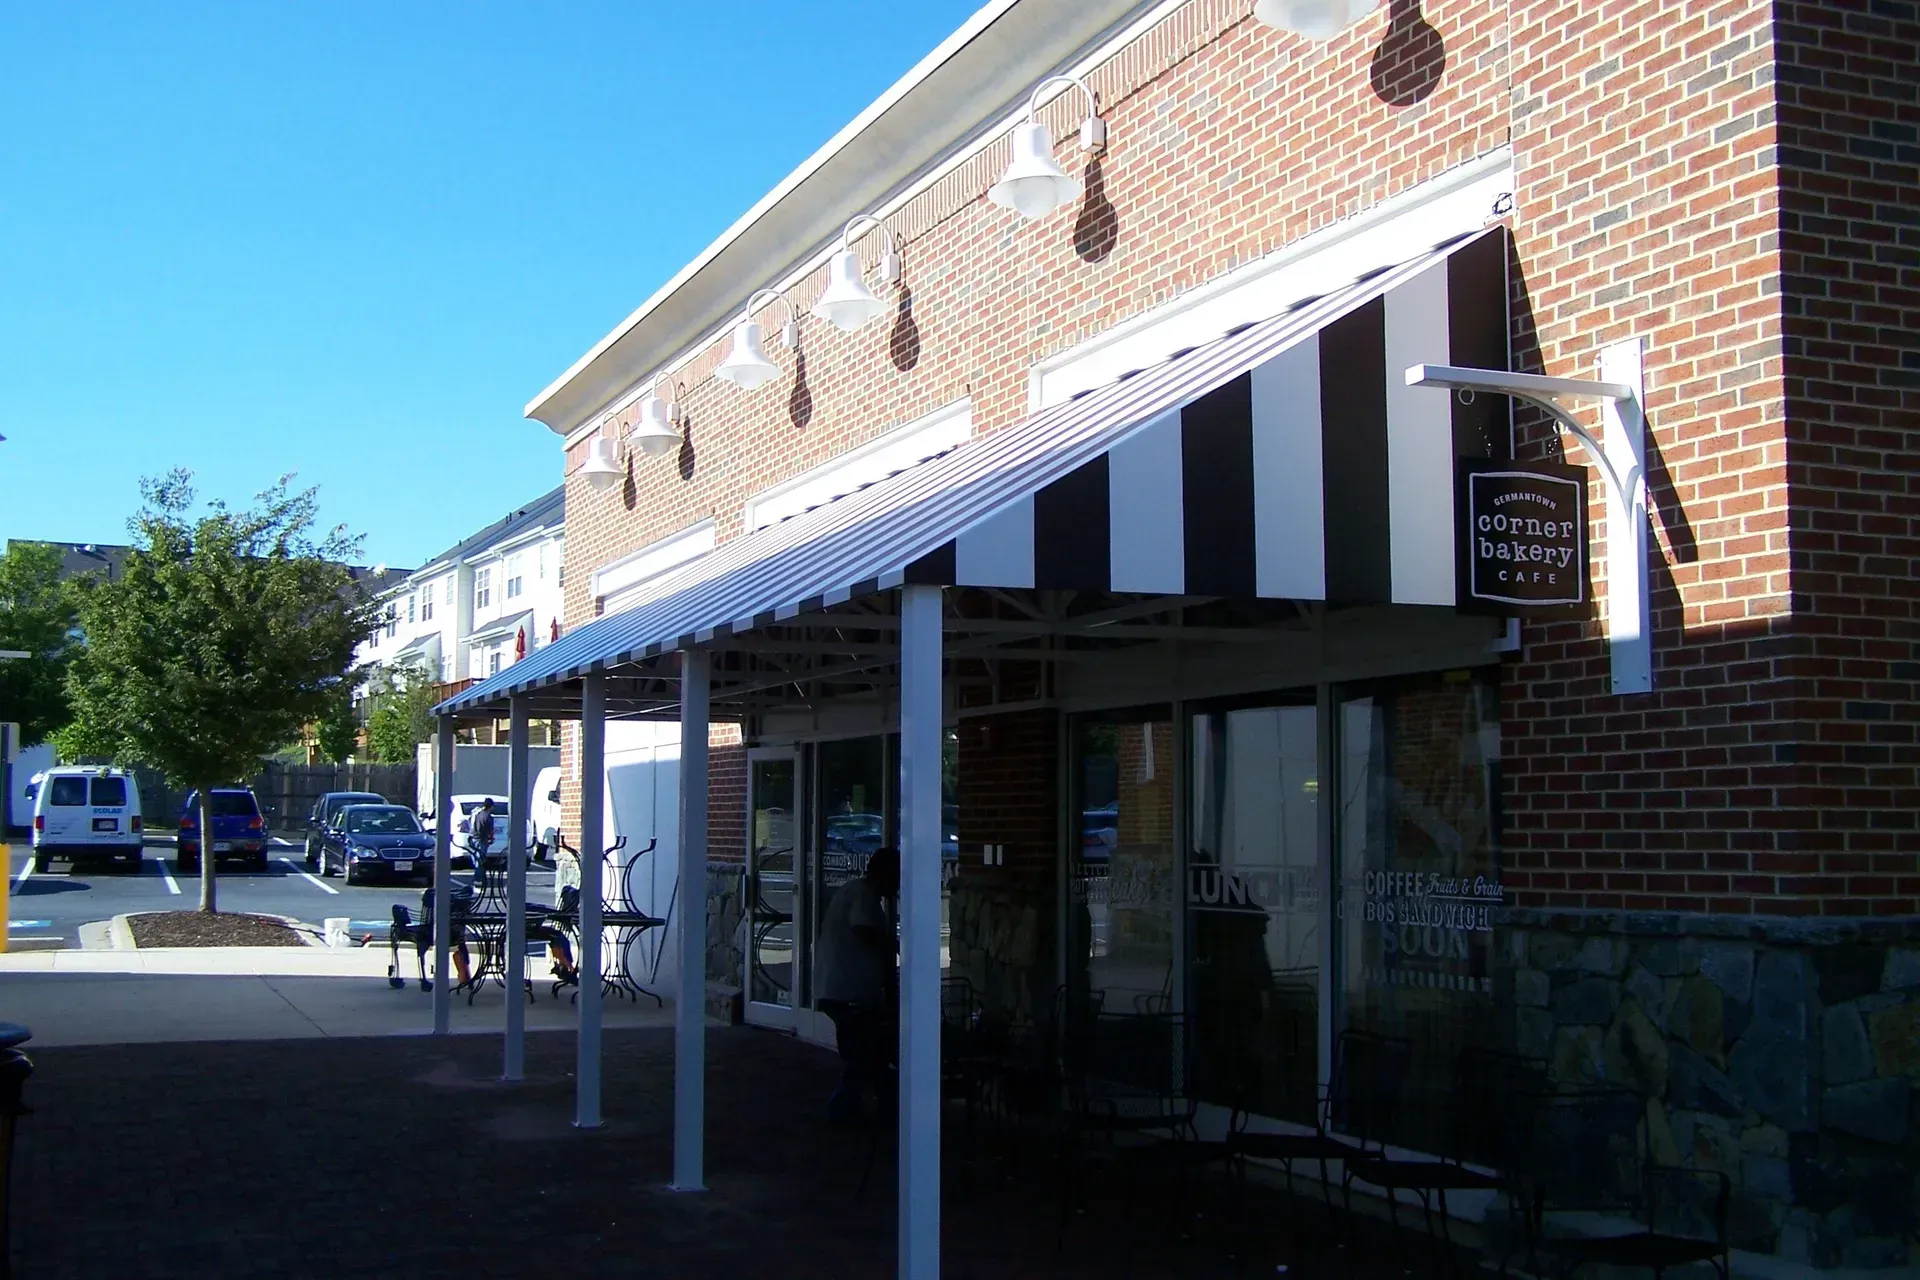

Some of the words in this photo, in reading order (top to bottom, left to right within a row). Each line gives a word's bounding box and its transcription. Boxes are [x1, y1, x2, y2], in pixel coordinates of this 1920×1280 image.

[1493, 492, 1557, 511] GERMANTOWN
[1478, 513, 1574, 539] corner
[1478, 537, 1574, 568] bakery
[1498, 570, 1556, 584] CAFE
[1365, 870, 1424, 897] COFFEE
[1426, 873, 1459, 895] Fruits
[1461, 878, 1470, 895] &
[1337, 900, 1395, 922] CBOS
